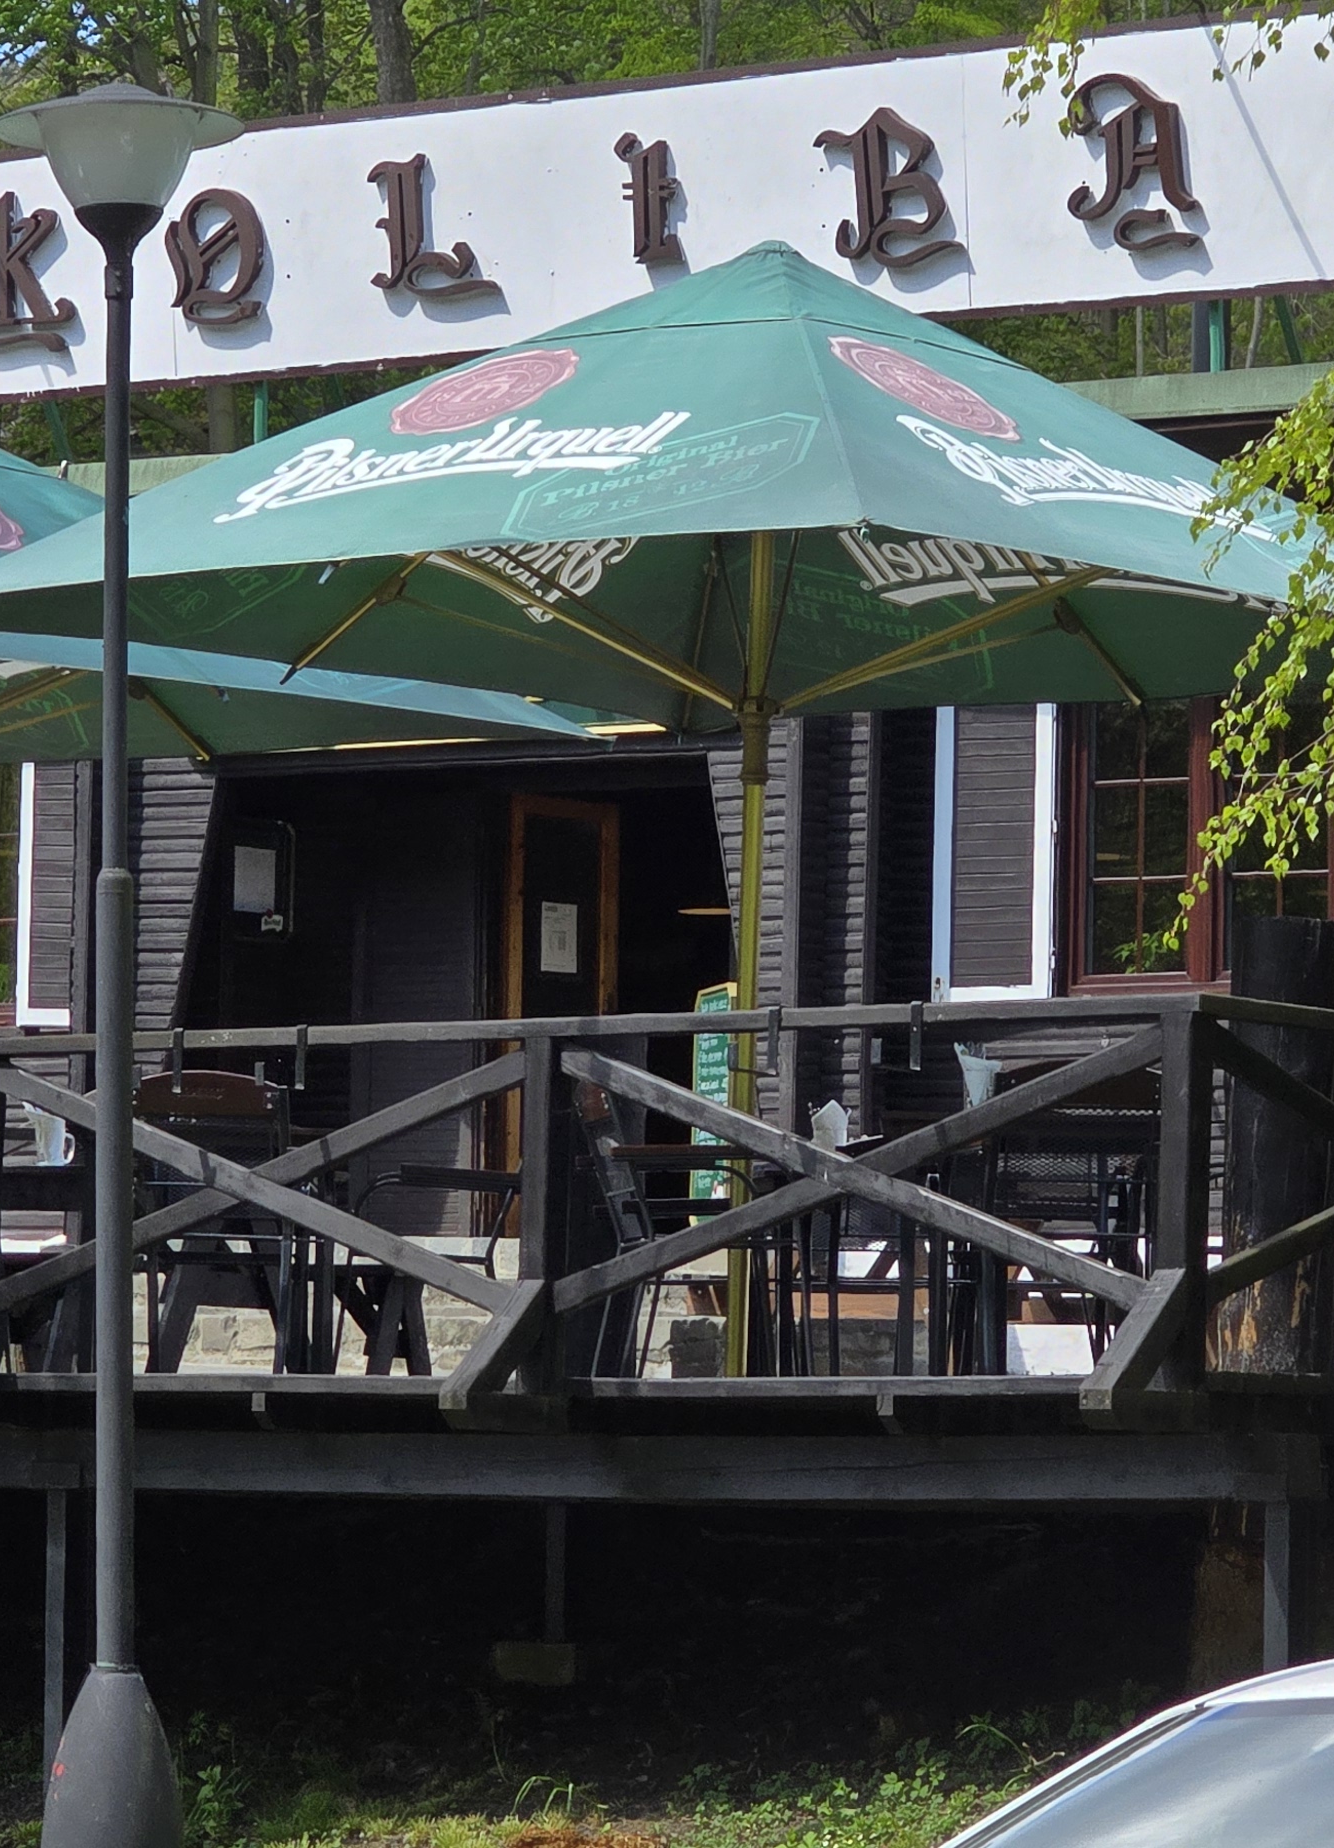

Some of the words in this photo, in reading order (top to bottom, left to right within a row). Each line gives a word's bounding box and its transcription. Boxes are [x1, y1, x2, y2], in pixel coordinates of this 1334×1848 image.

[213, 438, 482, 523] Pilsner
[459, 411, 691, 477] Urquell
[540, 463, 688, 507] Pilsner
[700, 438, 789, 468] Bier
